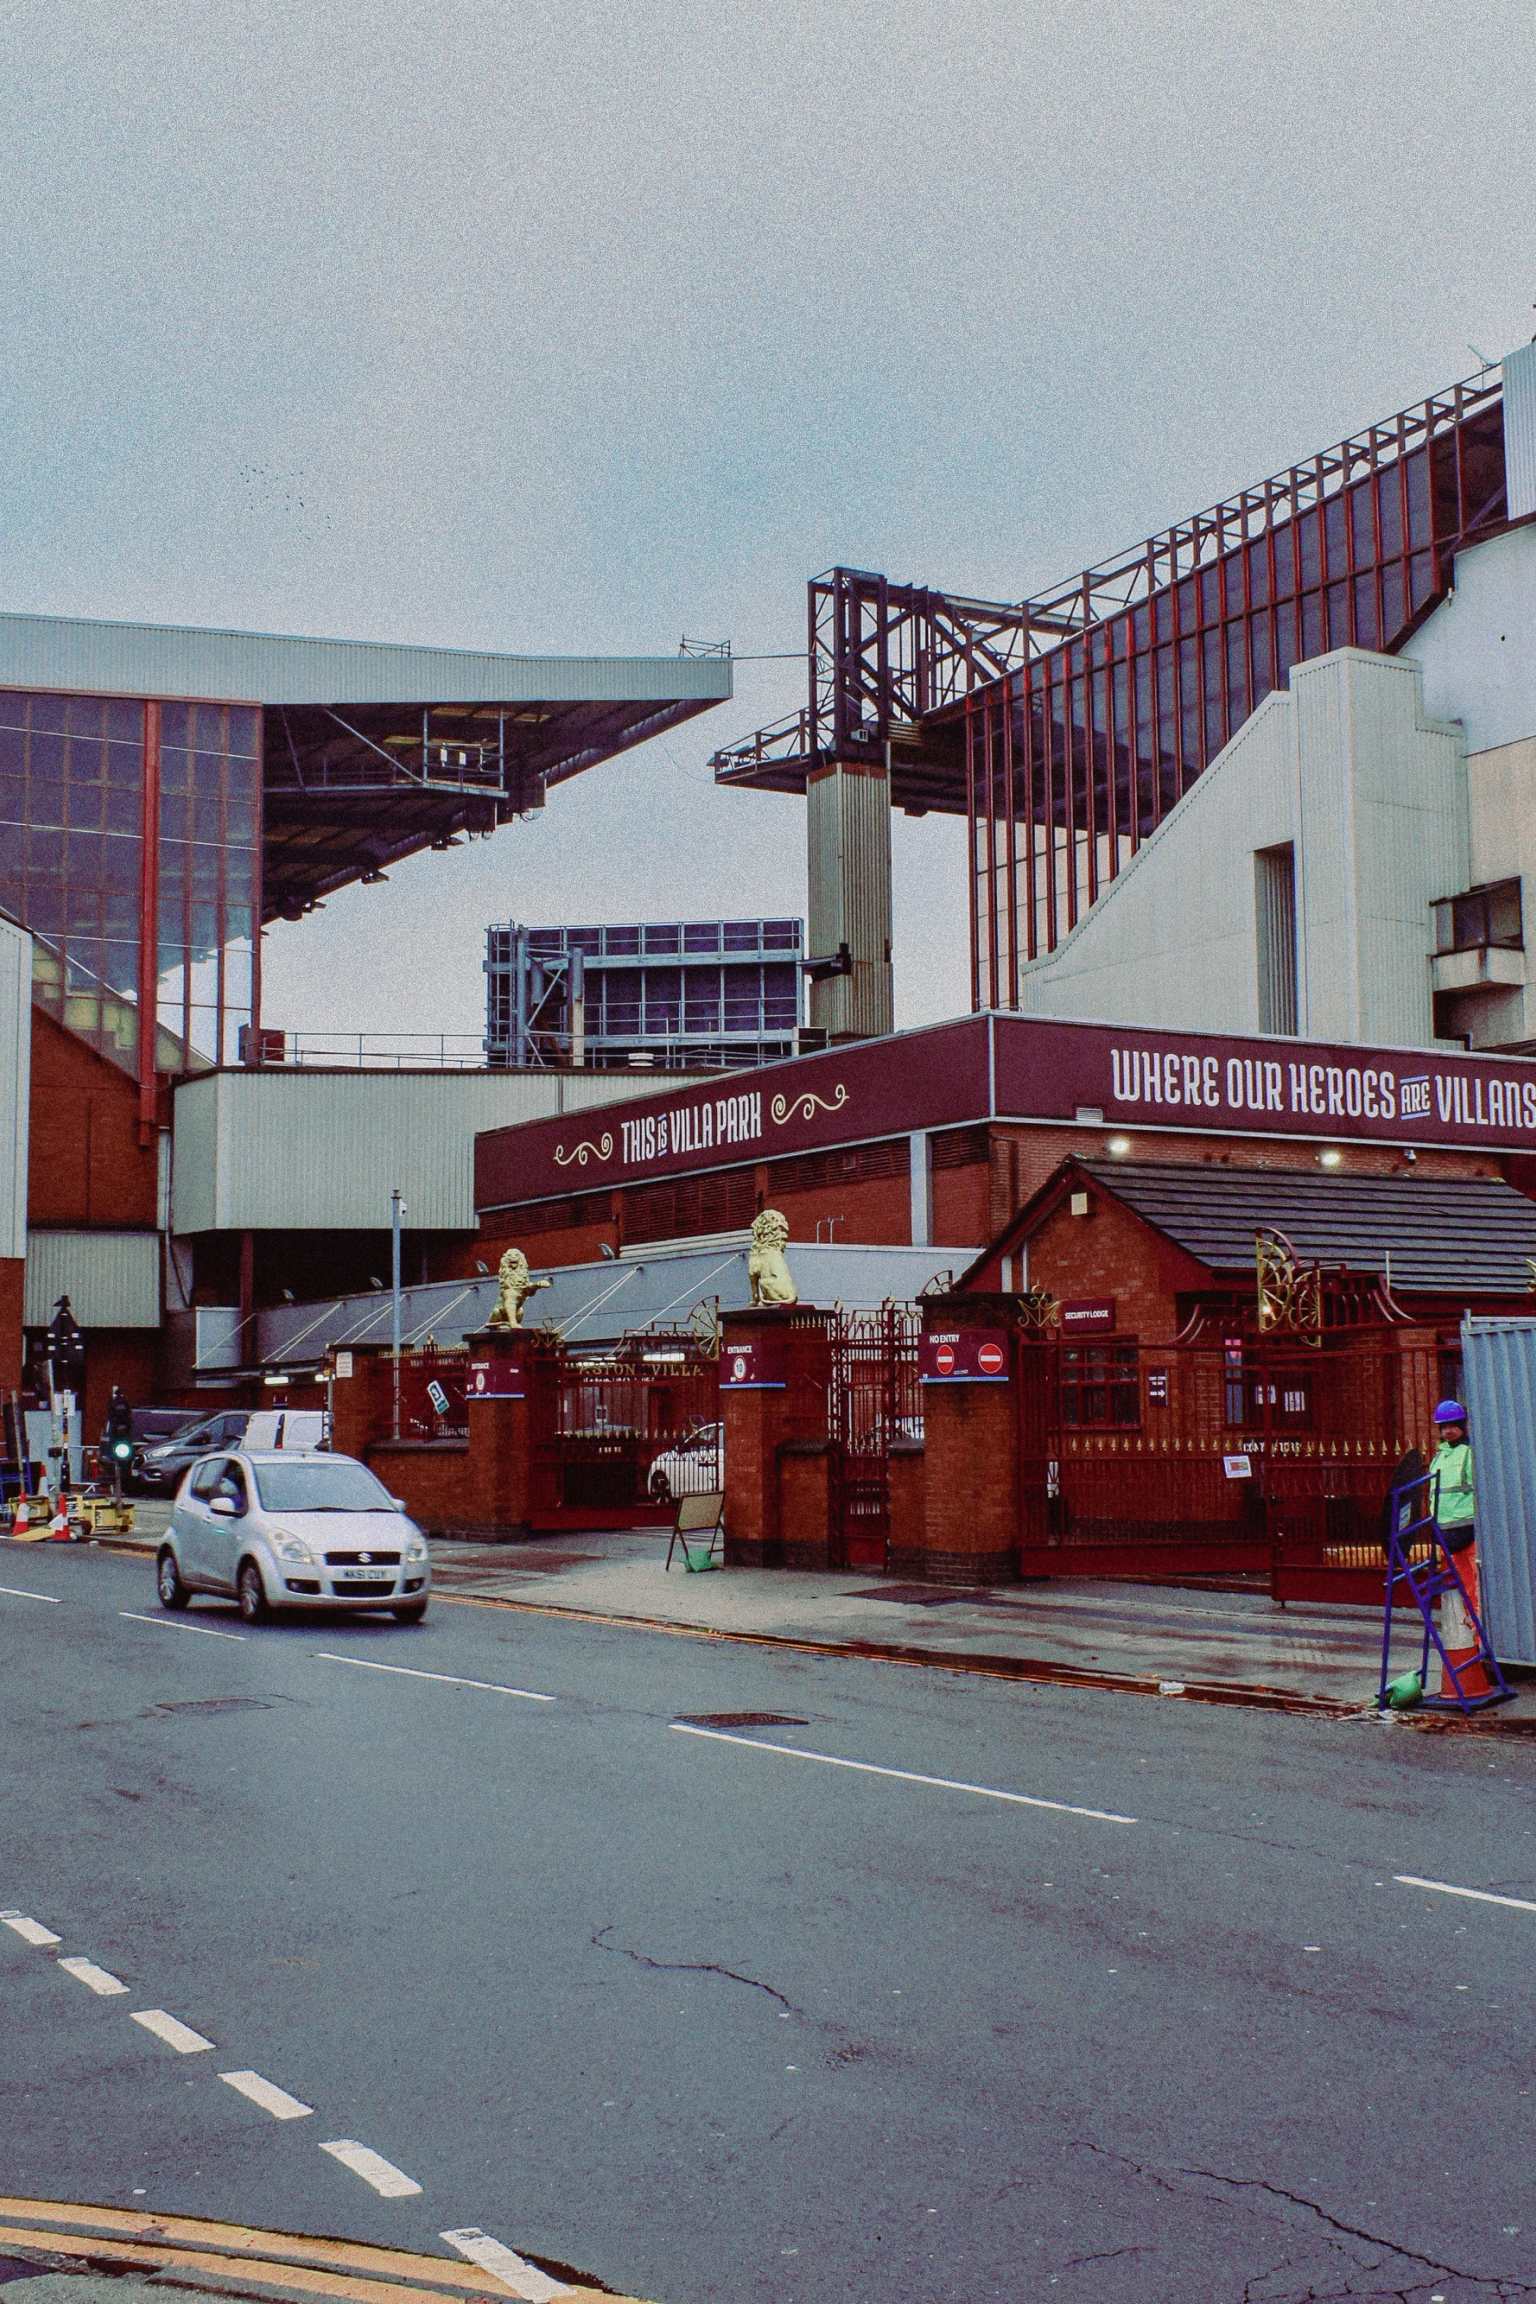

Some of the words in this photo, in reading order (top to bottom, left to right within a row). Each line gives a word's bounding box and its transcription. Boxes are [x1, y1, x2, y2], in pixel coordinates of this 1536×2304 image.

[1110, 1049, 1220, 1107] WHERE
[1226, 1058, 1284, 1111] OUR
[1288, 1063, 1396, 1119] HEROES
[1401, 1081, 1431, 1114] ARE
[1435, 1075, 1536, 1129] VILLANS
[620, 1116, 655, 1164] THIS
[657, 1119, 668, 1151] IS
[669, 1103, 713, 1154] VILLA
[716, 1091, 762, 1145] PARK
[1065, 1311, 1090, 1319] SECURITY
[1090, 1310, 1109, 1318] LODGE
[929, 1335, 939, 1344] NO
[940, 1334, 960, 1343] ENTRY
[727, 1345, 752, 1354] ENTRANCE
